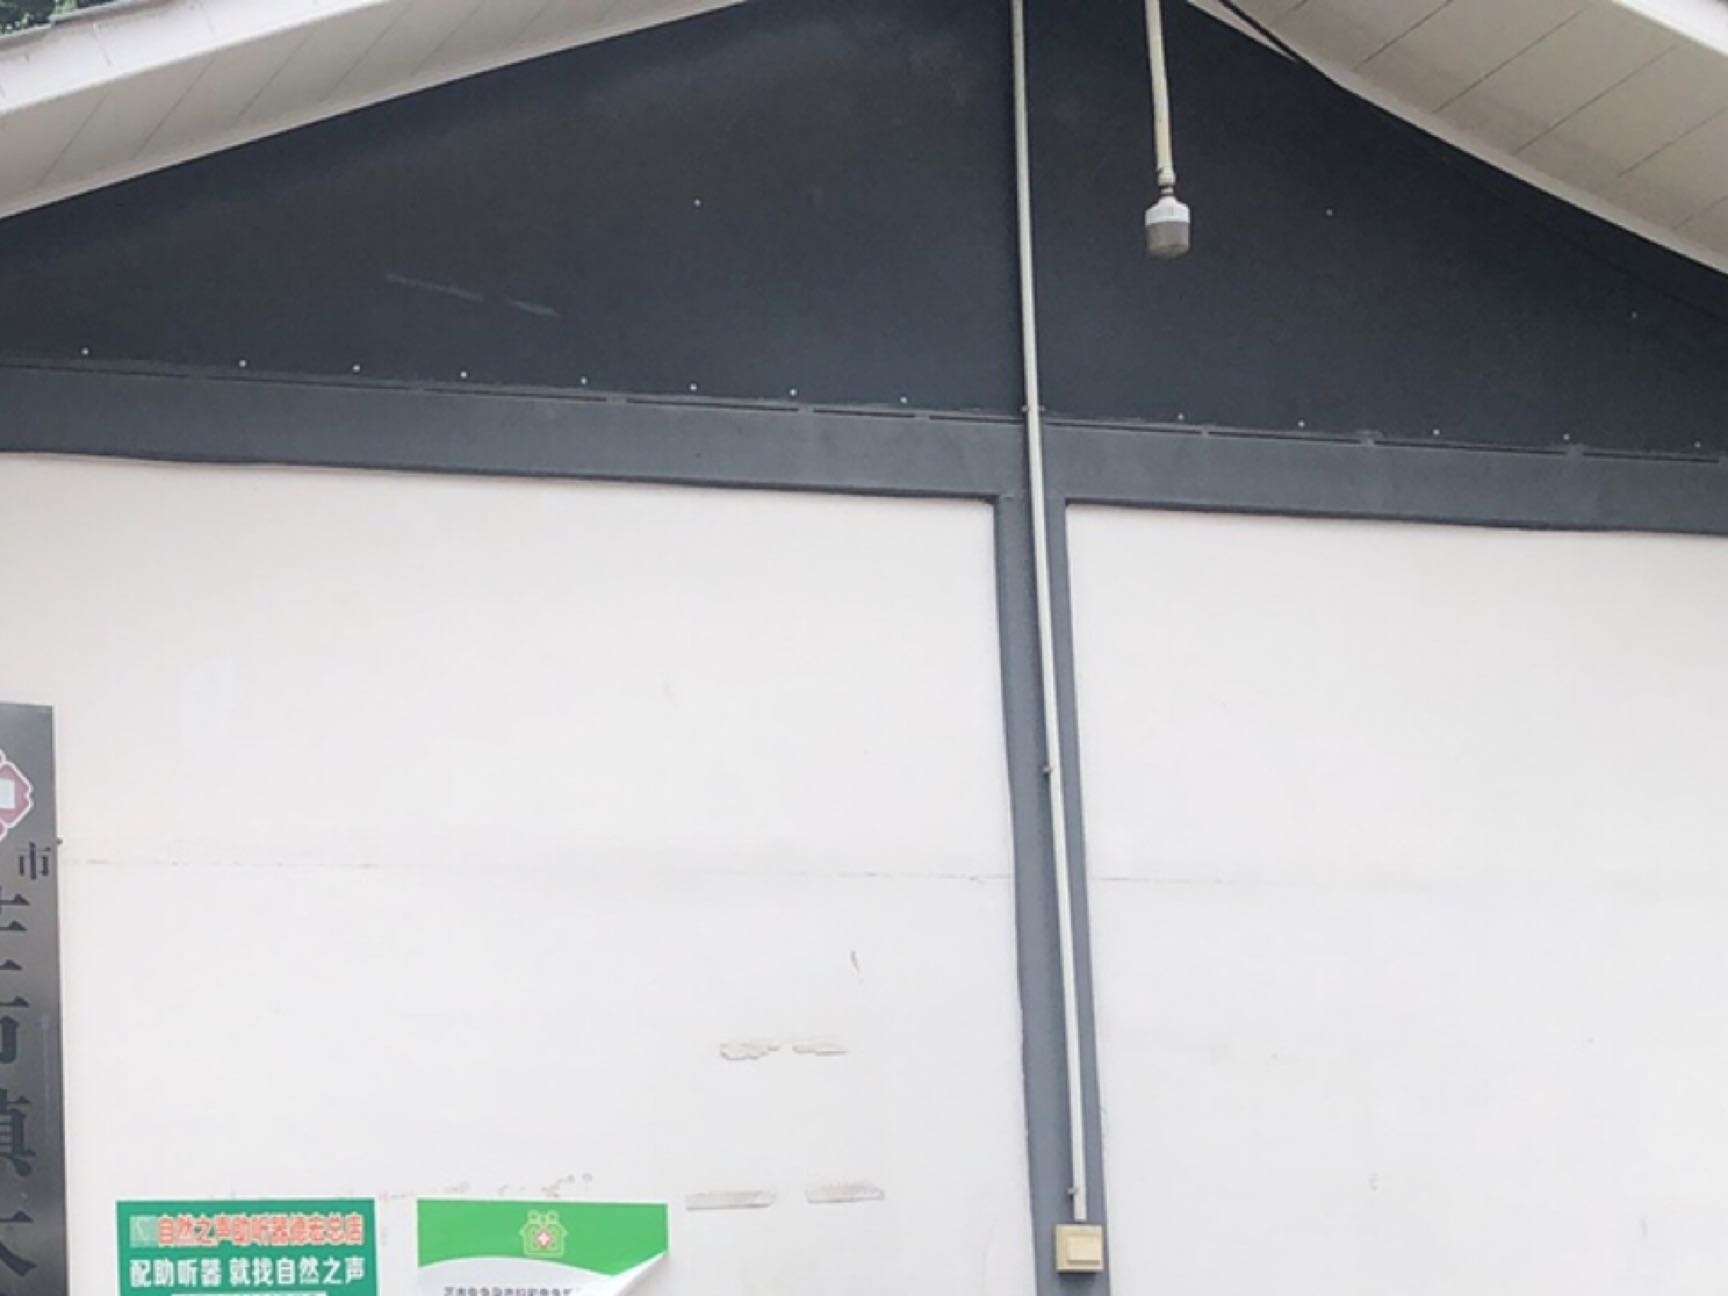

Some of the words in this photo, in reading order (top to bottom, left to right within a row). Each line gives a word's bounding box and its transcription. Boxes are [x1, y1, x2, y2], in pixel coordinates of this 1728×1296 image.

[129, 1257, 223, 1288] 配助听器
[228, 1255, 366, 1286] 就找自然之声
